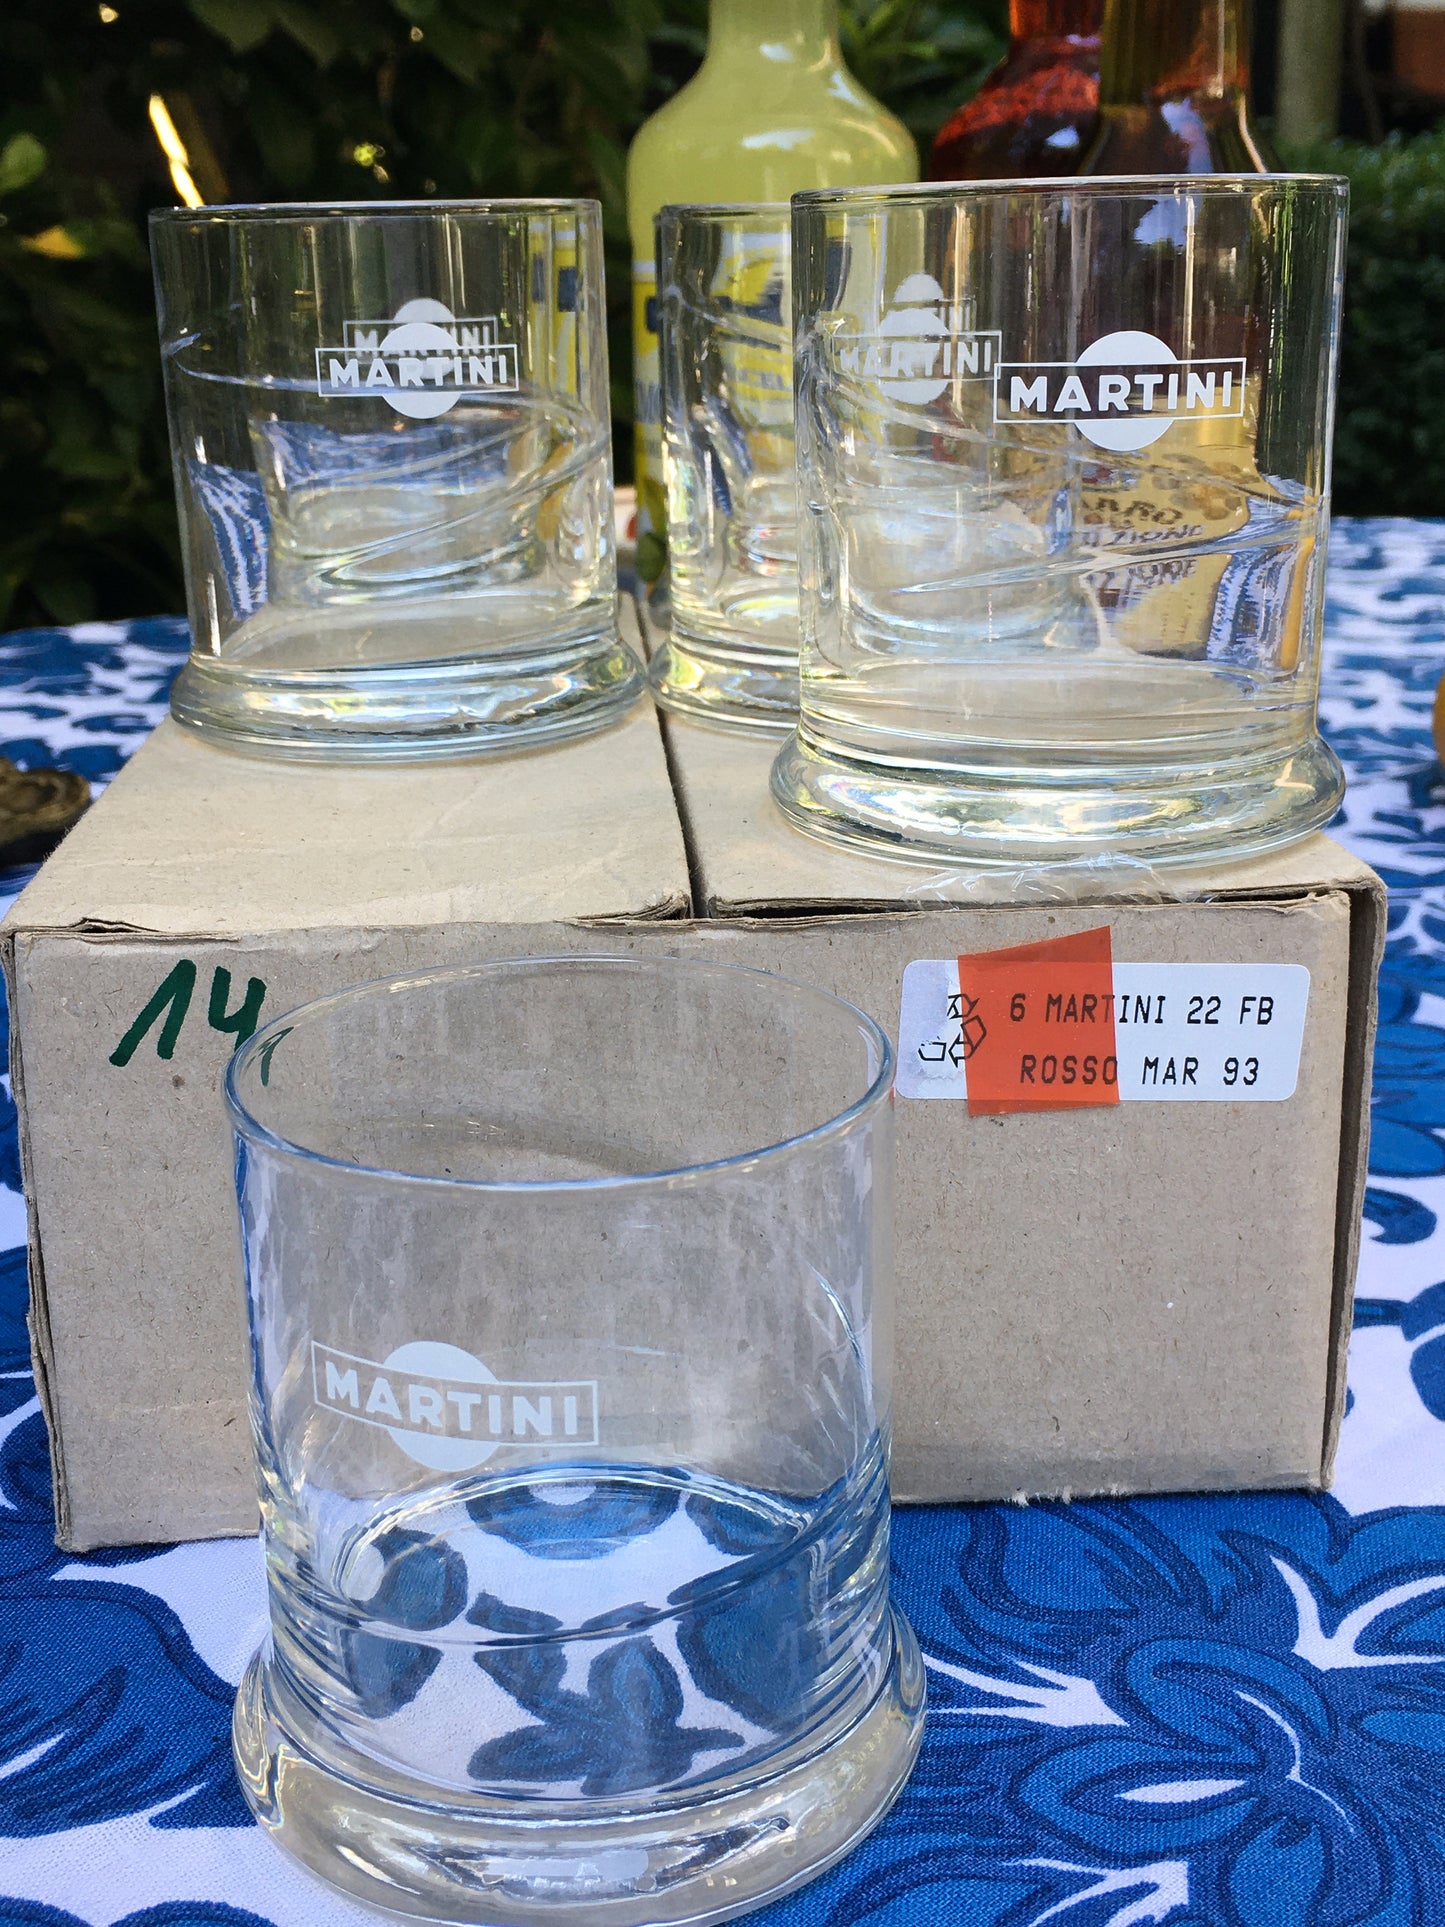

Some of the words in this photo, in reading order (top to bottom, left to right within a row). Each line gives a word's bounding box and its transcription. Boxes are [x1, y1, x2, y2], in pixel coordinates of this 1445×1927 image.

[328, 354, 508, 389] MARTINI
[839, 339, 992, 378] MARTINI
[1009, 370, 1234, 413] MARTINI
[1009, 992, 1027, 1023] 6
[1045, 993, 1167, 1025] MARTINI
[1186, 995, 1222, 1025] 22
[1239, 996, 1275, 1025] FB
[1020, 1054, 1118, 1085] ROSSO
[1141, 1056, 1200, 1085] MAR
[1222, 1056, 1260, 1086] 93
[324, 1360, 579, 1437] MARTINI
